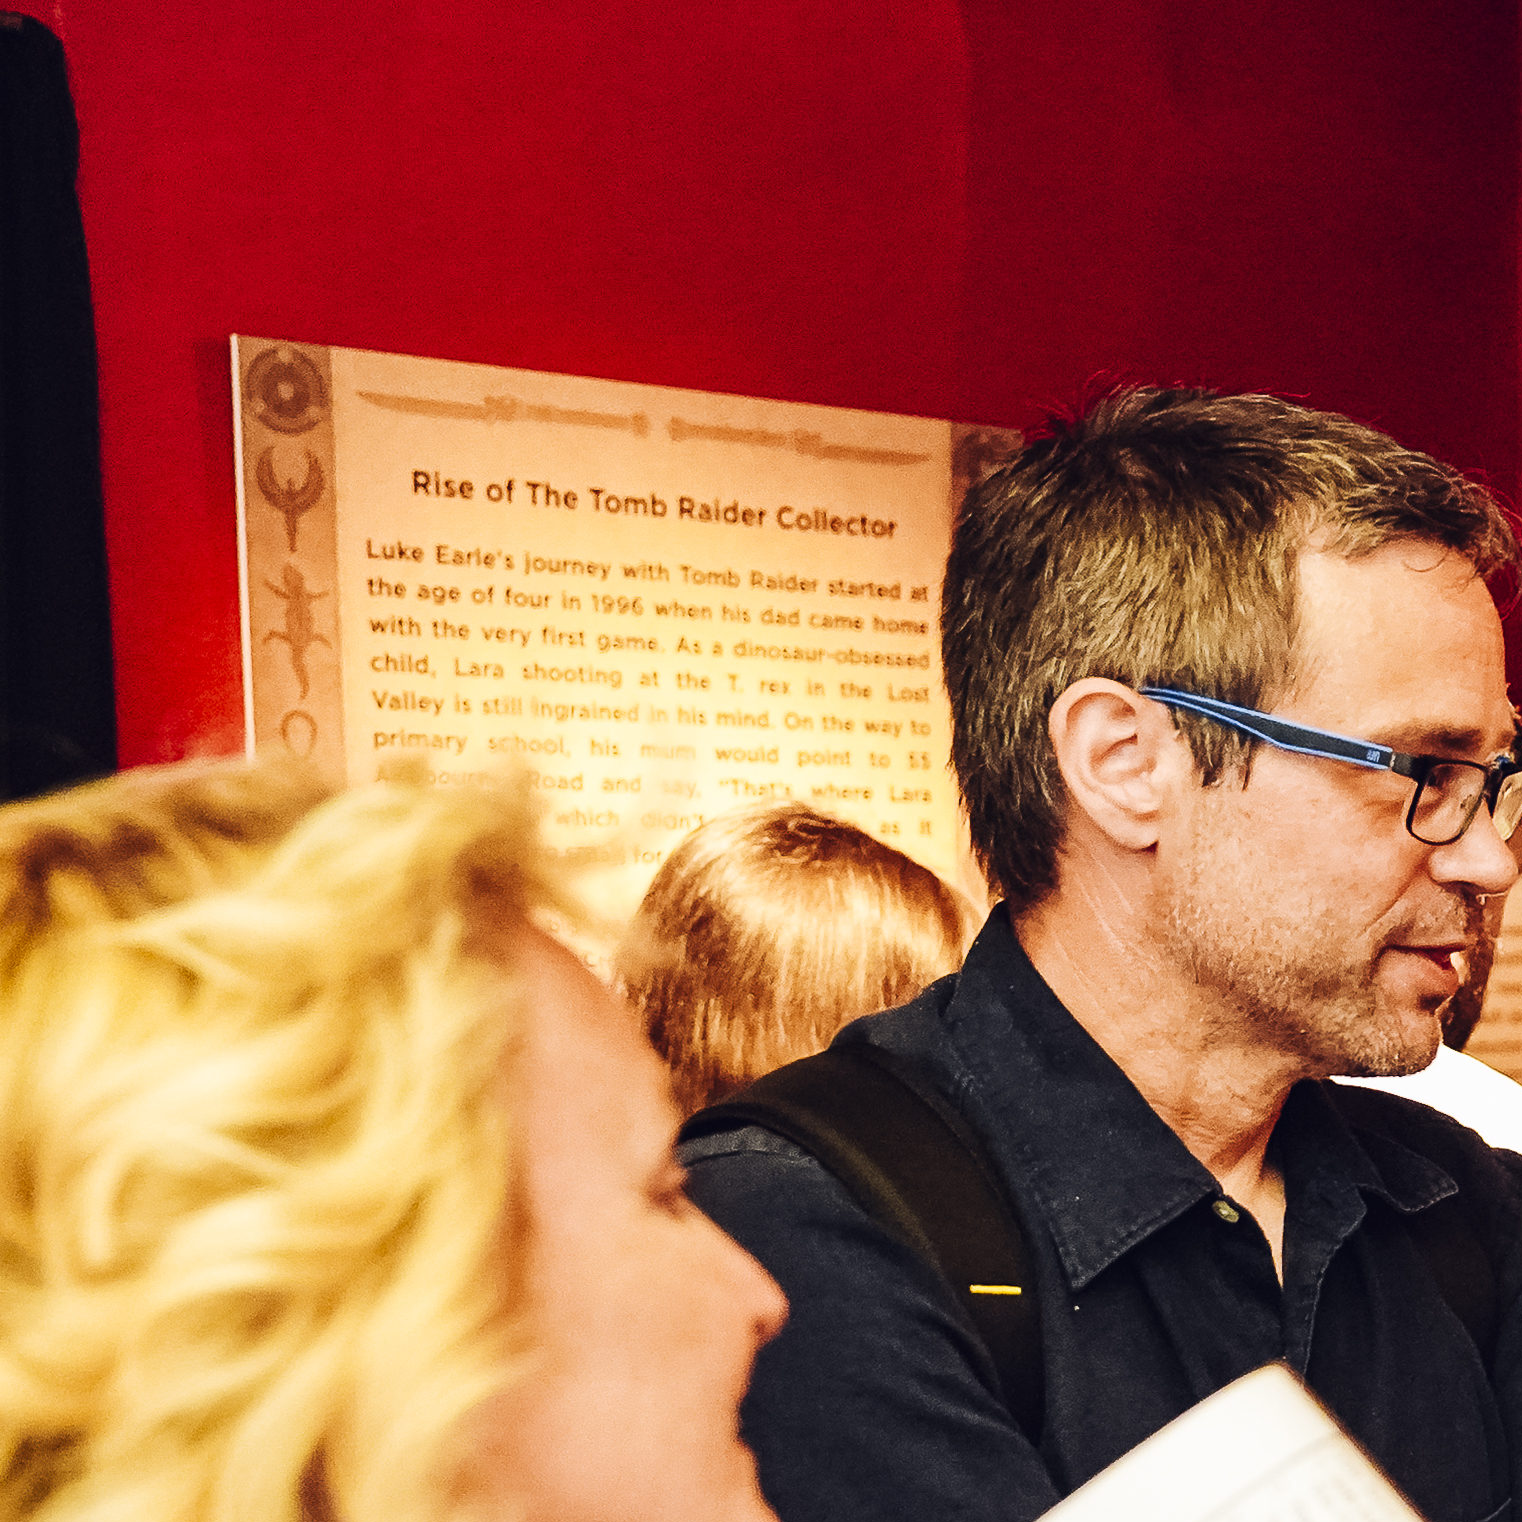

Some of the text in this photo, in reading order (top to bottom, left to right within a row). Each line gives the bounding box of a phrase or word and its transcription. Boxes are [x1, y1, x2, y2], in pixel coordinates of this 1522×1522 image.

[412, 470, 897, 537] Rise of The Tomb Raider Collector
[366, 539, 928, 602] Luke Earle's journey with Tomb Raider started at
[367, 577, 406, 598] the
[417, 585, 461, 605] age
[471, 584, 494, 604] of
[505, 587, 551, 608] four
[561, 591, 581, 610] in
[654, 601, 712, 619] when
[721, 605, 751, 623] his
[760, 608, 800, 627] dad
[808, 613, 864, 630] came
[872, 616, 929, 635] home
[369, 616, 421, 636] with
[432, 619, 470, 640] the
[482, 627, 530, 646] very
[541, 626, 585, 647] first
[676, 635, 702, 655] As
[712, 641, 723, 656] a
